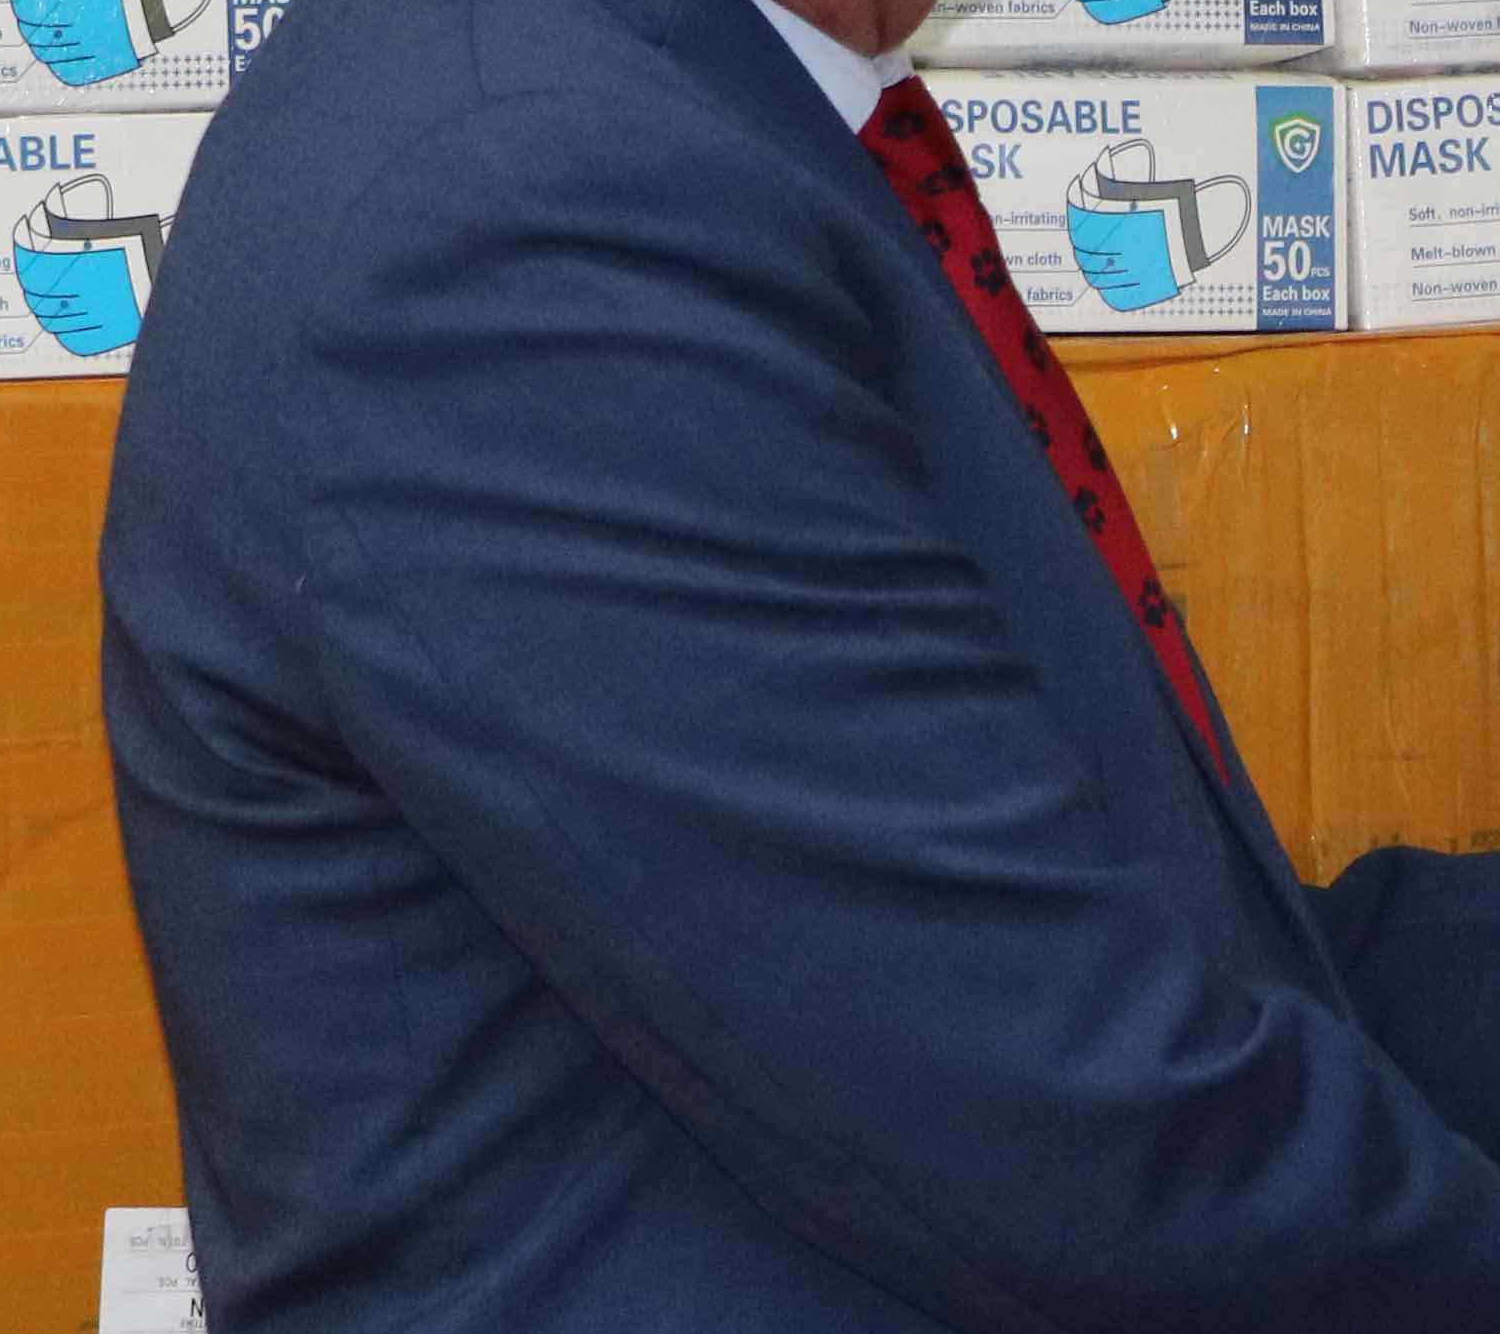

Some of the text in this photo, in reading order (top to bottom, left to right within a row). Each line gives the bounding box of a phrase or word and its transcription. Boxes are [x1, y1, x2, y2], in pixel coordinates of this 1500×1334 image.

[1249, 0, 1318, 16] Each box
[941, 99, 1142, 134] SPOSABLE
[971, 142, 1023, 179] SK
[1370, 136, 1491, 179] MASK
[1262, 215, 1330, 238] MASK
[1263, 240, 1311, 281] 50
[1411, 243, 1495, 262] Melt-blown
[1262, 286, 1329, 301] Each box
[1413, 278, 1497, 297] Non-woven
